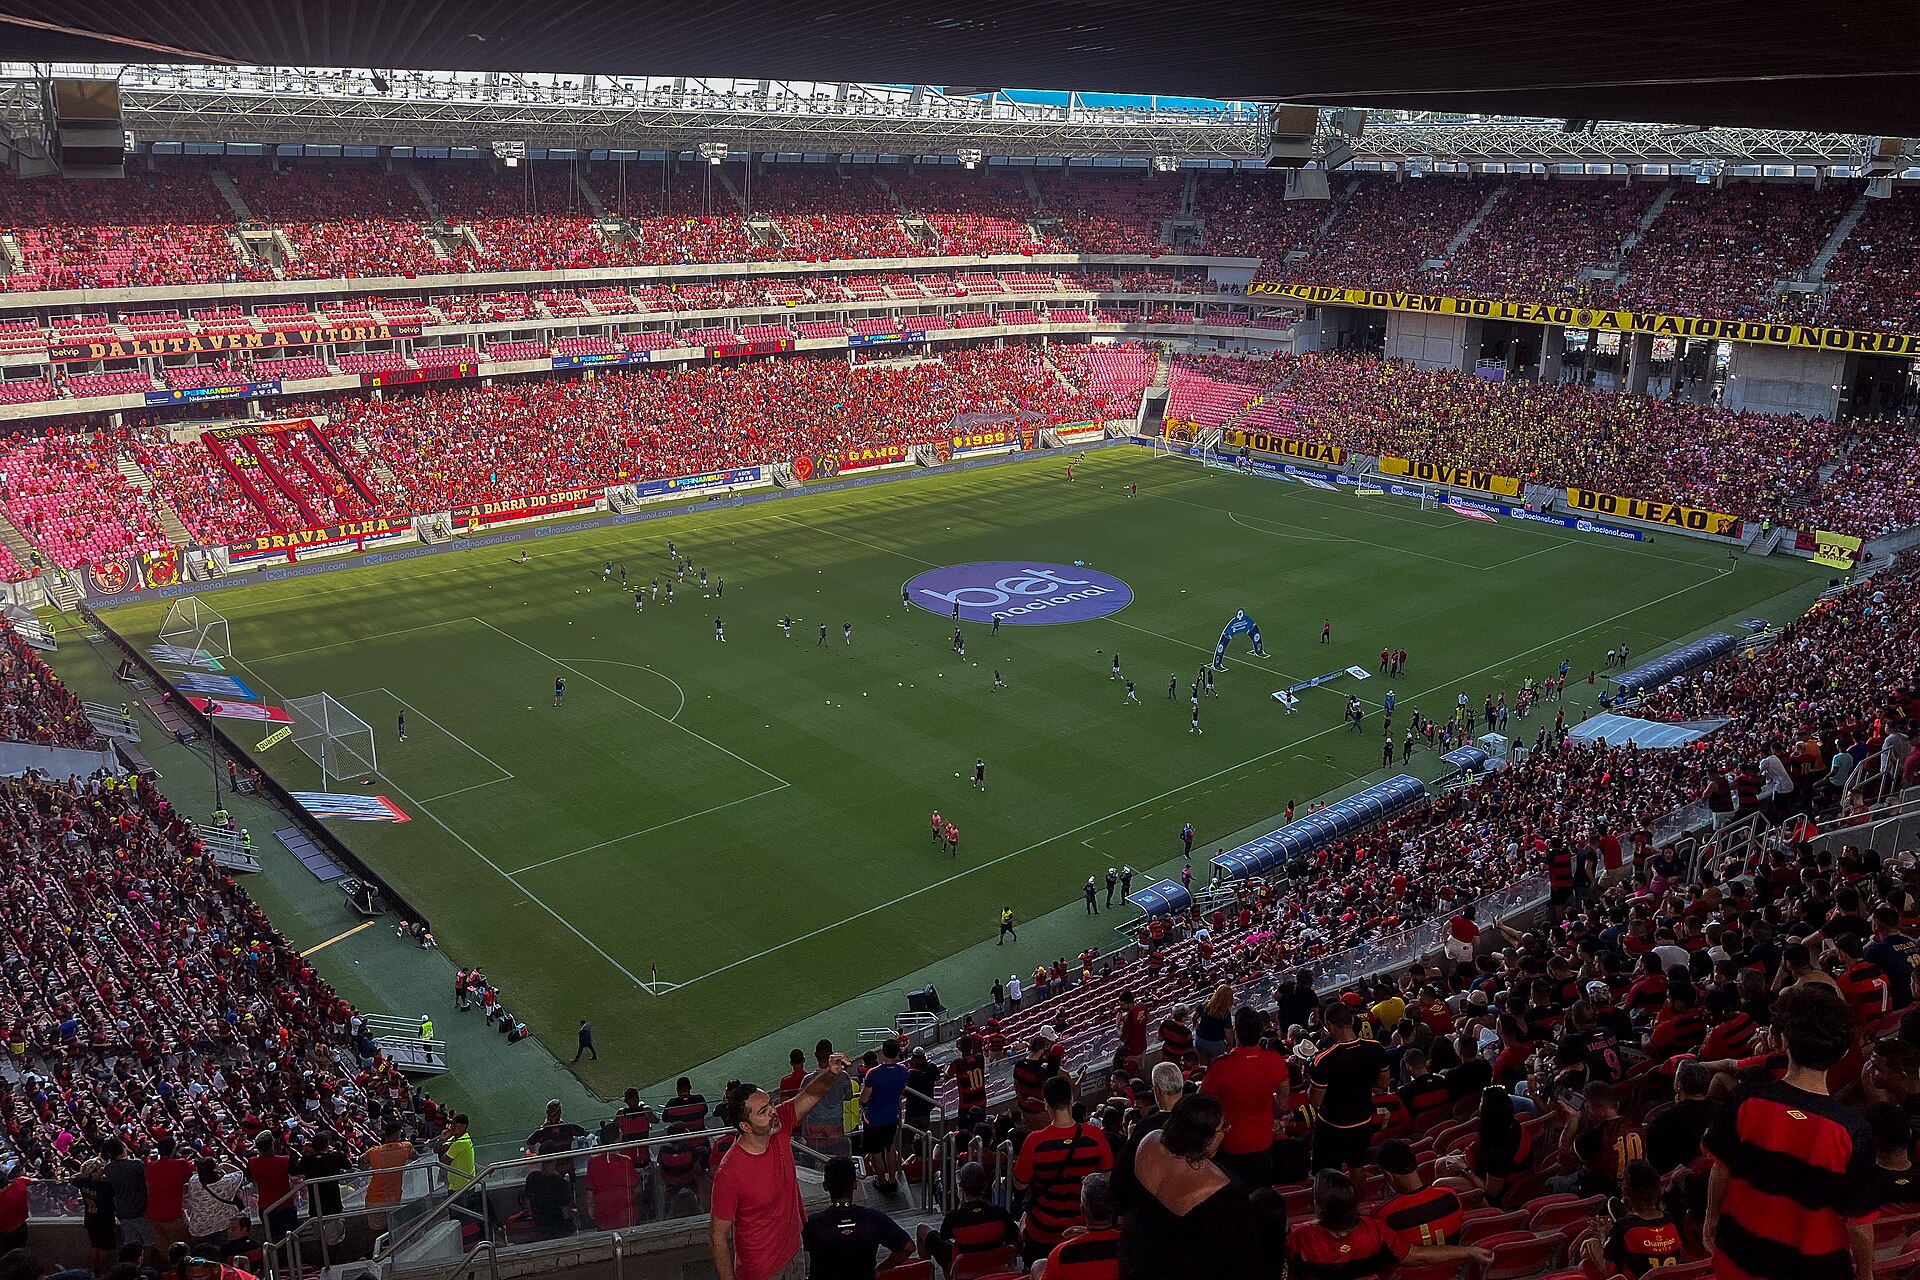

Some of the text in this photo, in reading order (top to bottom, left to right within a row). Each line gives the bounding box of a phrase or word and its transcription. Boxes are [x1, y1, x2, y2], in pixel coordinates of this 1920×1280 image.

[1251, 282, 1346, 301] TORCIDA
[1358, 291, 1442, 313] JOVEM
[1454, 299, 1490, 315] DO
[1597, 312, 1620, 328] A
[52, 348, 80, 358] betvip
[89, 342, 126, 359] DA
[132, 337, 204, 356] LUTA
[209, 334, 264, 349] VEM
[274, 332, 288, 345] A
[398, 326, 420, 335] betvip
[580, 353, 627, 362] PERNAMBUCO
[183, 385, 249, 397] PERNAMBUCO
[849, 446, 898, 461] GANG
[1243, 432, 1336, 463] TORCIDA
[677, 473, 732, 486] PERNAMBUCO
[1402, 460, 1492, 490] JOVEM
[471, 505, 480, 516] A
[484, 498, 528, 515] BARRA
[530, 495, 547, 507] DO
[550, 489, 589, 504] SPORT
[1578, 491, 1618, 514] DO
[1512, 507, 1565, 526] betnacional.com
[257, 529, 328, 550] BRAVA
[339, 519, 390, 536] ILHA
[1577, 520, 1635, 540] betnacional.com
[452, 534, 521, 551] betnacional.com
[1820, 544, 1853, 560] PAZ
[363, 547, 438, 566] betnacional.com
[266, 561, 347, 581] betnacional.com
[159, 576, 248, 599] betnacional.com
[920, 568, 1090, 607] bet
[990, 585, 1115, 620] nacional
[260, 728, 290, 749] quartzolit
[1603, 1048, 1621, 1080] 9
[967, 1066, 984, 1091] 10
[1643, 1236, 1676, 1248] Champion
